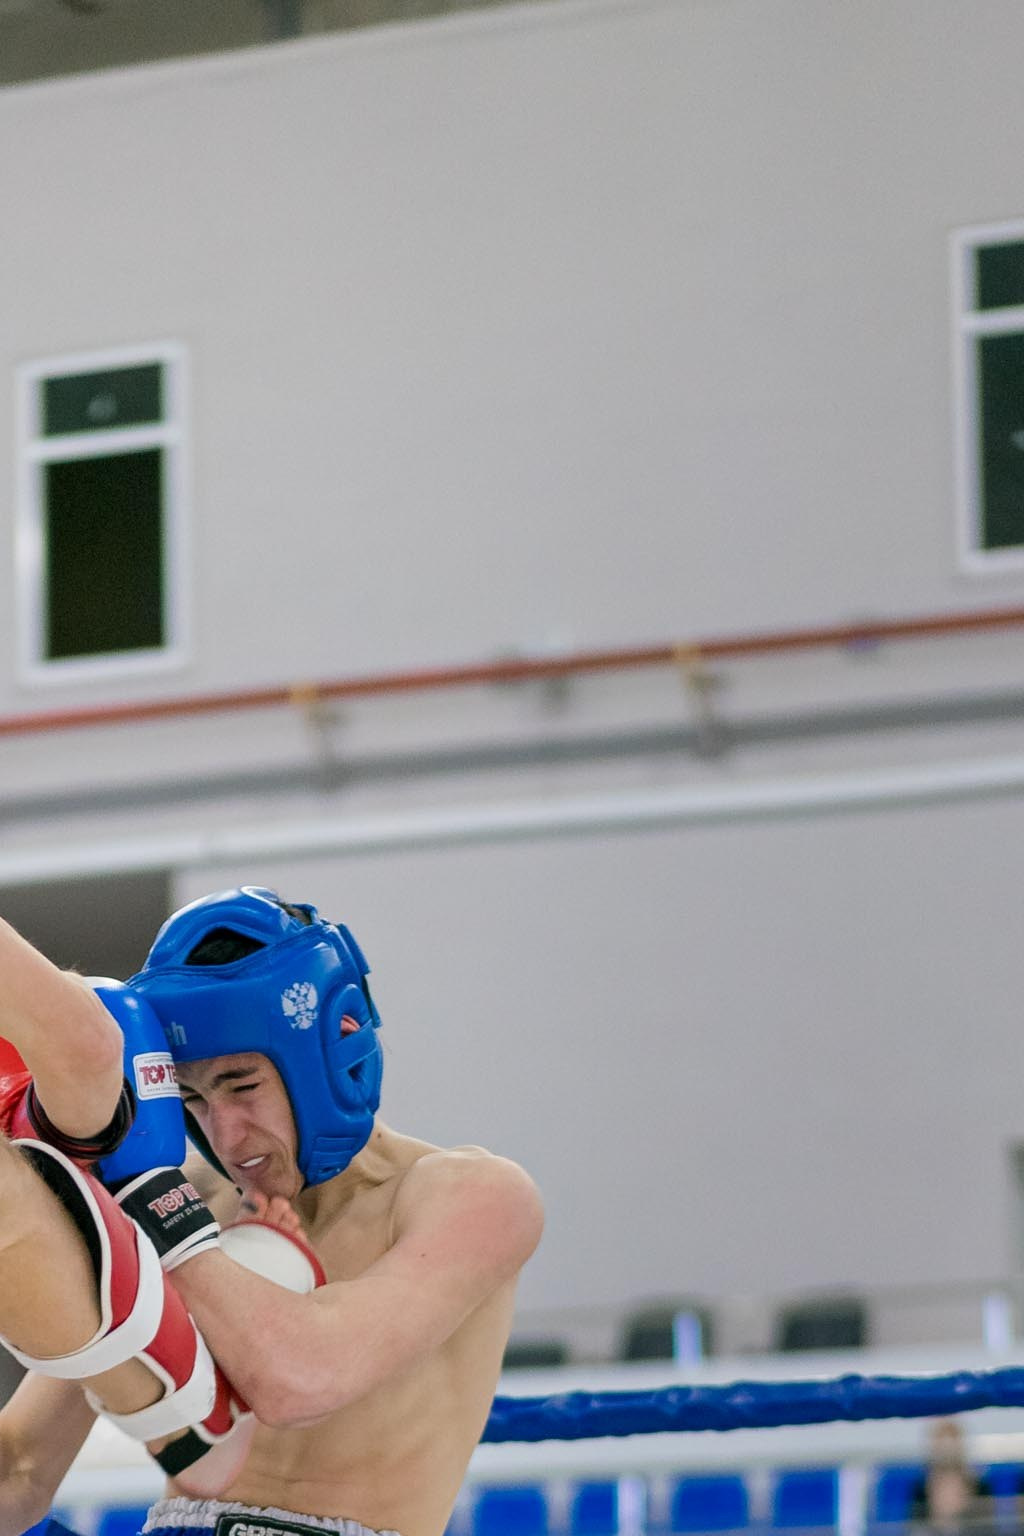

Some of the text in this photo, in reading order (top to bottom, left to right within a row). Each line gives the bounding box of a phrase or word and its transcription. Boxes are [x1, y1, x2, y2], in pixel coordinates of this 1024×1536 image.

[139, 1063, 177, 1086] TOP TE
[147, 1188, 185, 1218] TOP
[178, 1182, 201, 1201] TE
